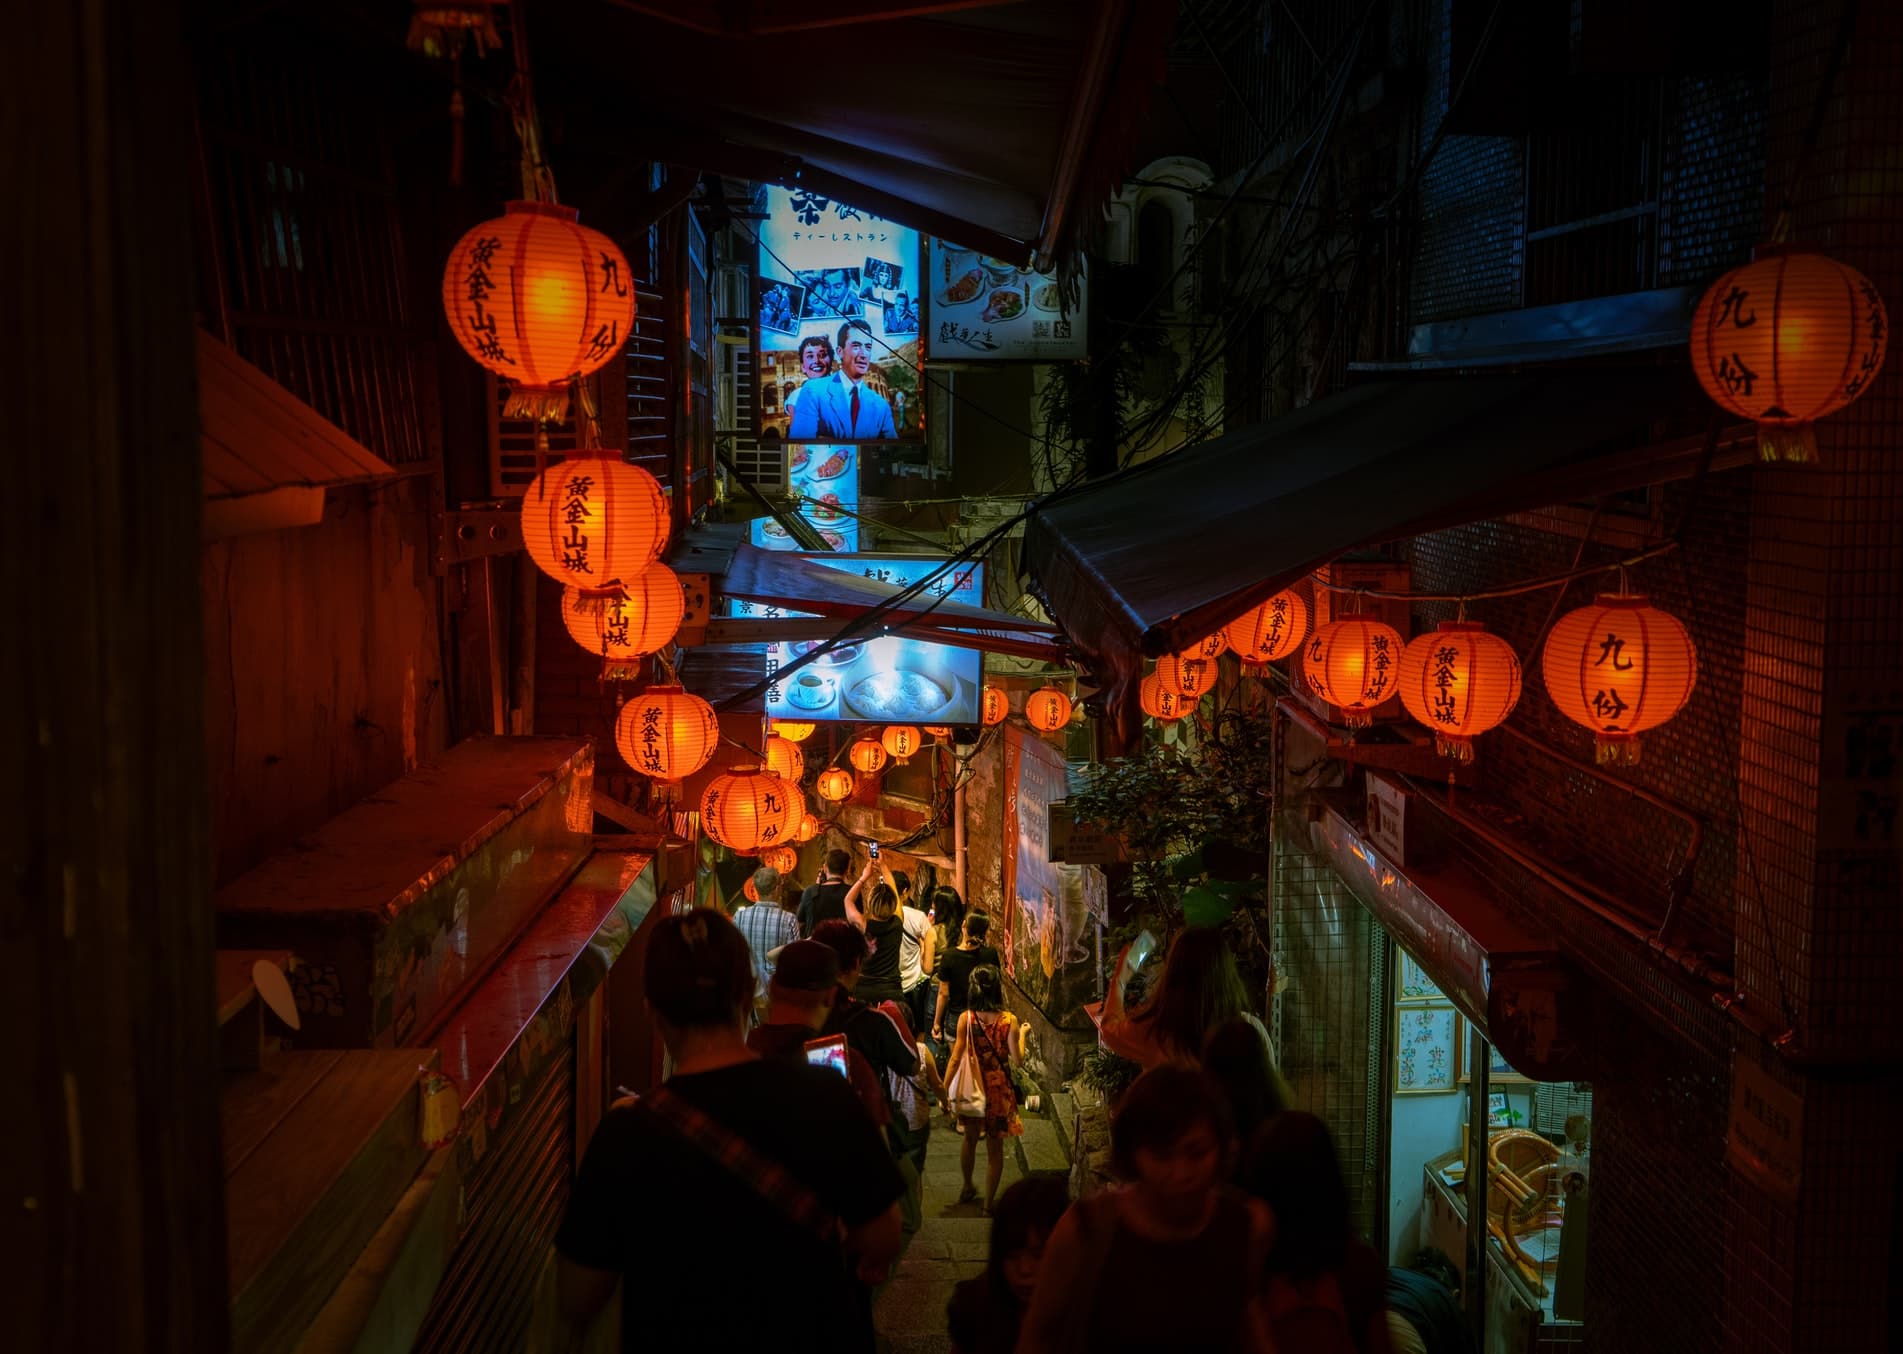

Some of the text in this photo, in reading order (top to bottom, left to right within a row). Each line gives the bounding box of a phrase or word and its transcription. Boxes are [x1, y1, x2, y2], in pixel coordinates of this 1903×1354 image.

[467, 237, 516, 366] 黃金山城
[586, 251, 628, 362] 九份
[1716, 287, 1758, 395] 九份
[561, 476, 594, 575] 黃金山城
[1260, 597, 1289, 656] 黃金山城
[1365, 635, 1393, 700] 黃金山城
[1432, 646, 1460, 727] 黃金山城
[1592, 633, 1632, 720] 九份
[640, 707, 666, 773] 黃金山城
[762, 792, 782, 842] 九份
